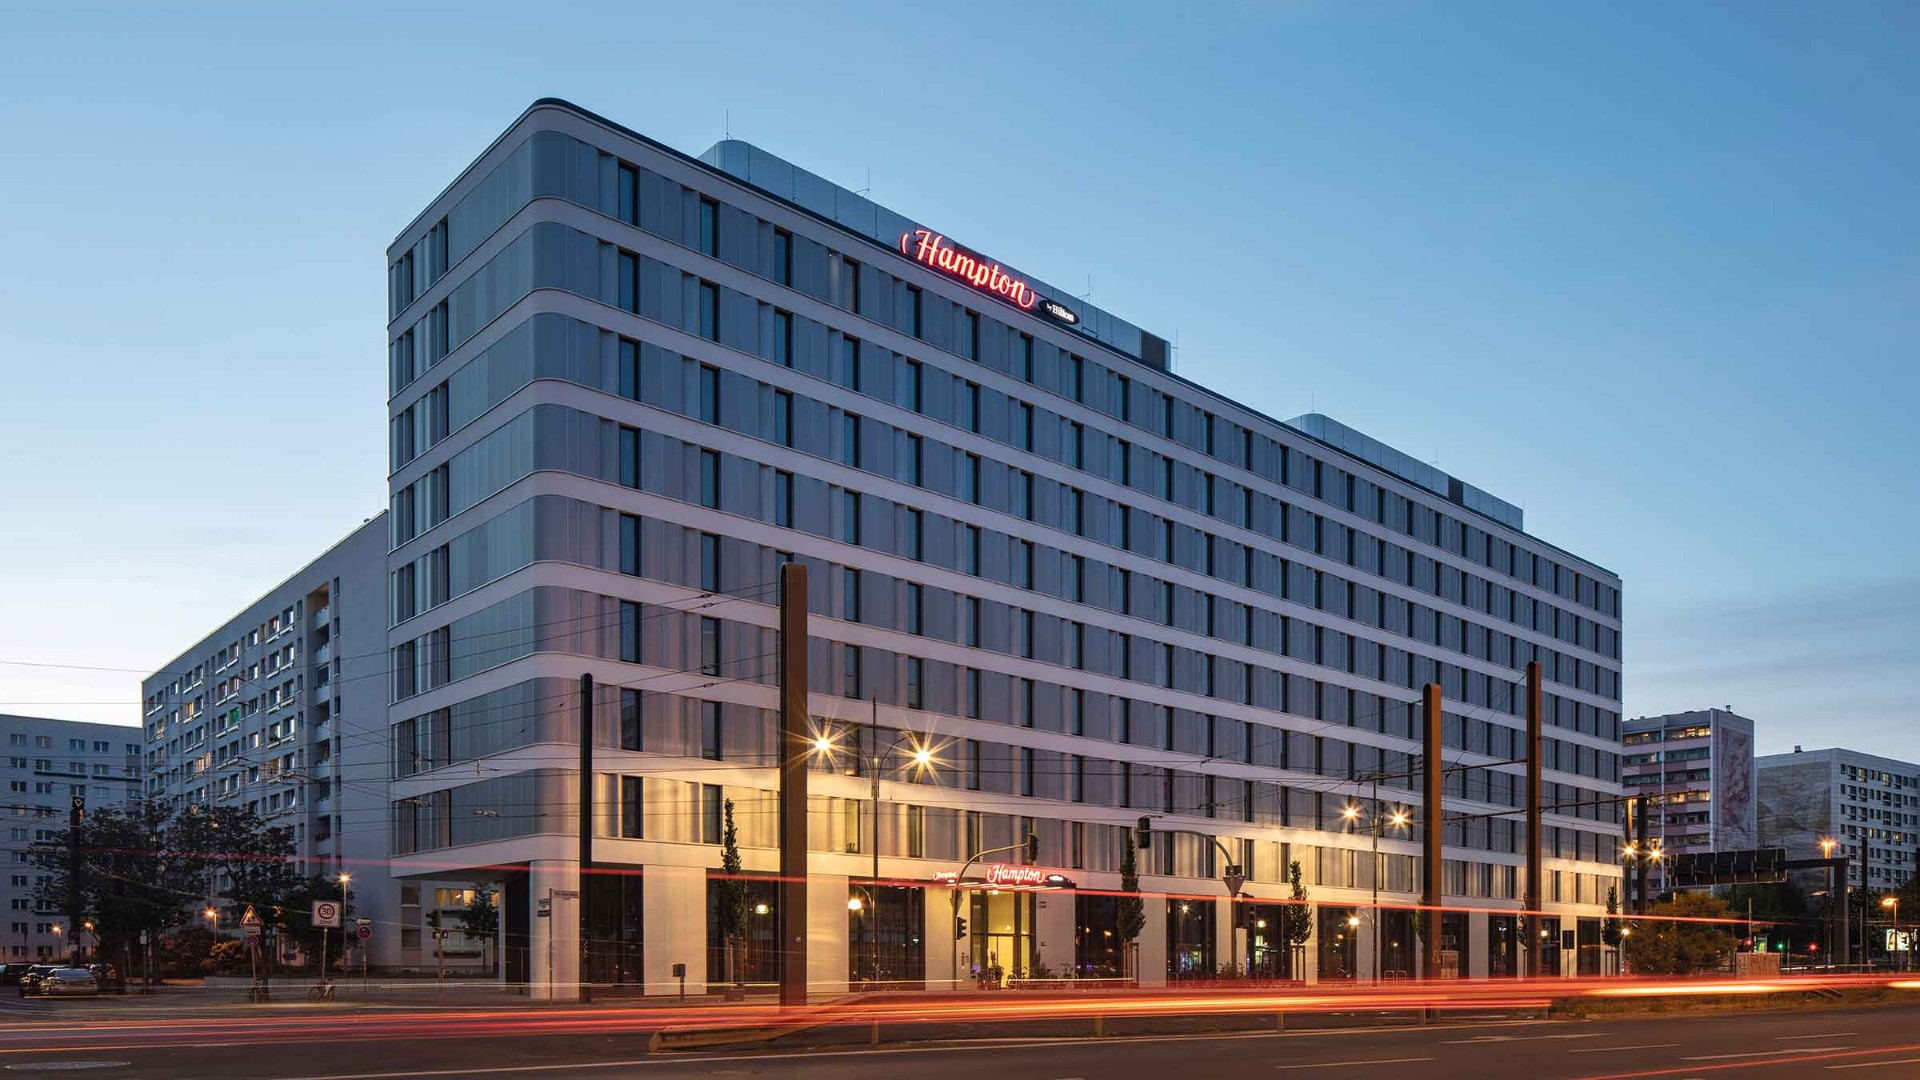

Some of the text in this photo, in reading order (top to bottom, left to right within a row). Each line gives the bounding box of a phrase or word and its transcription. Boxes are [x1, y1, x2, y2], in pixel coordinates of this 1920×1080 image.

[902, 230, 1035, 308] Hampton
[987, 864, 1045, 884] Hampton
[321, 907, 332, 915] 30
